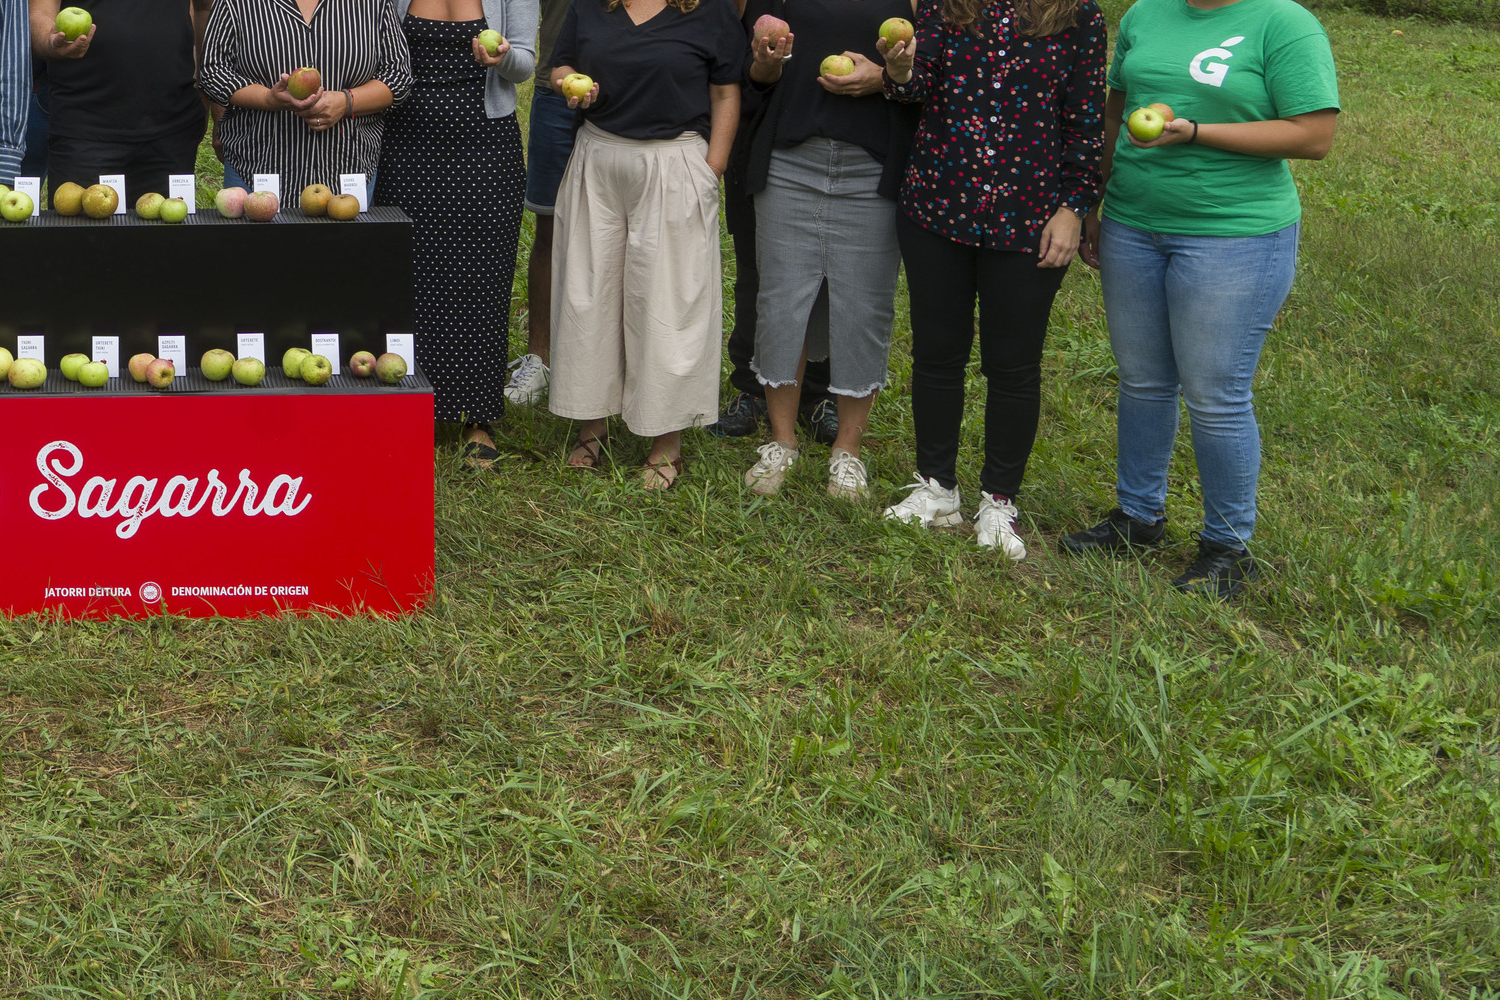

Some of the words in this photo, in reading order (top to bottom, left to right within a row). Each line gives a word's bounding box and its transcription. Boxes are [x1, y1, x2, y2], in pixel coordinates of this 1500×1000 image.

[29, 440, 312, 539] Sagarra
[44, 587, 86, 599] JATORRI
[88, 587, 132, 597] DEITURA
[171, 584, 252, 596] DENOMINACIÓN
[254, 586, 268, 596] DE
[269, 586, 309, 596] ORIGEN
